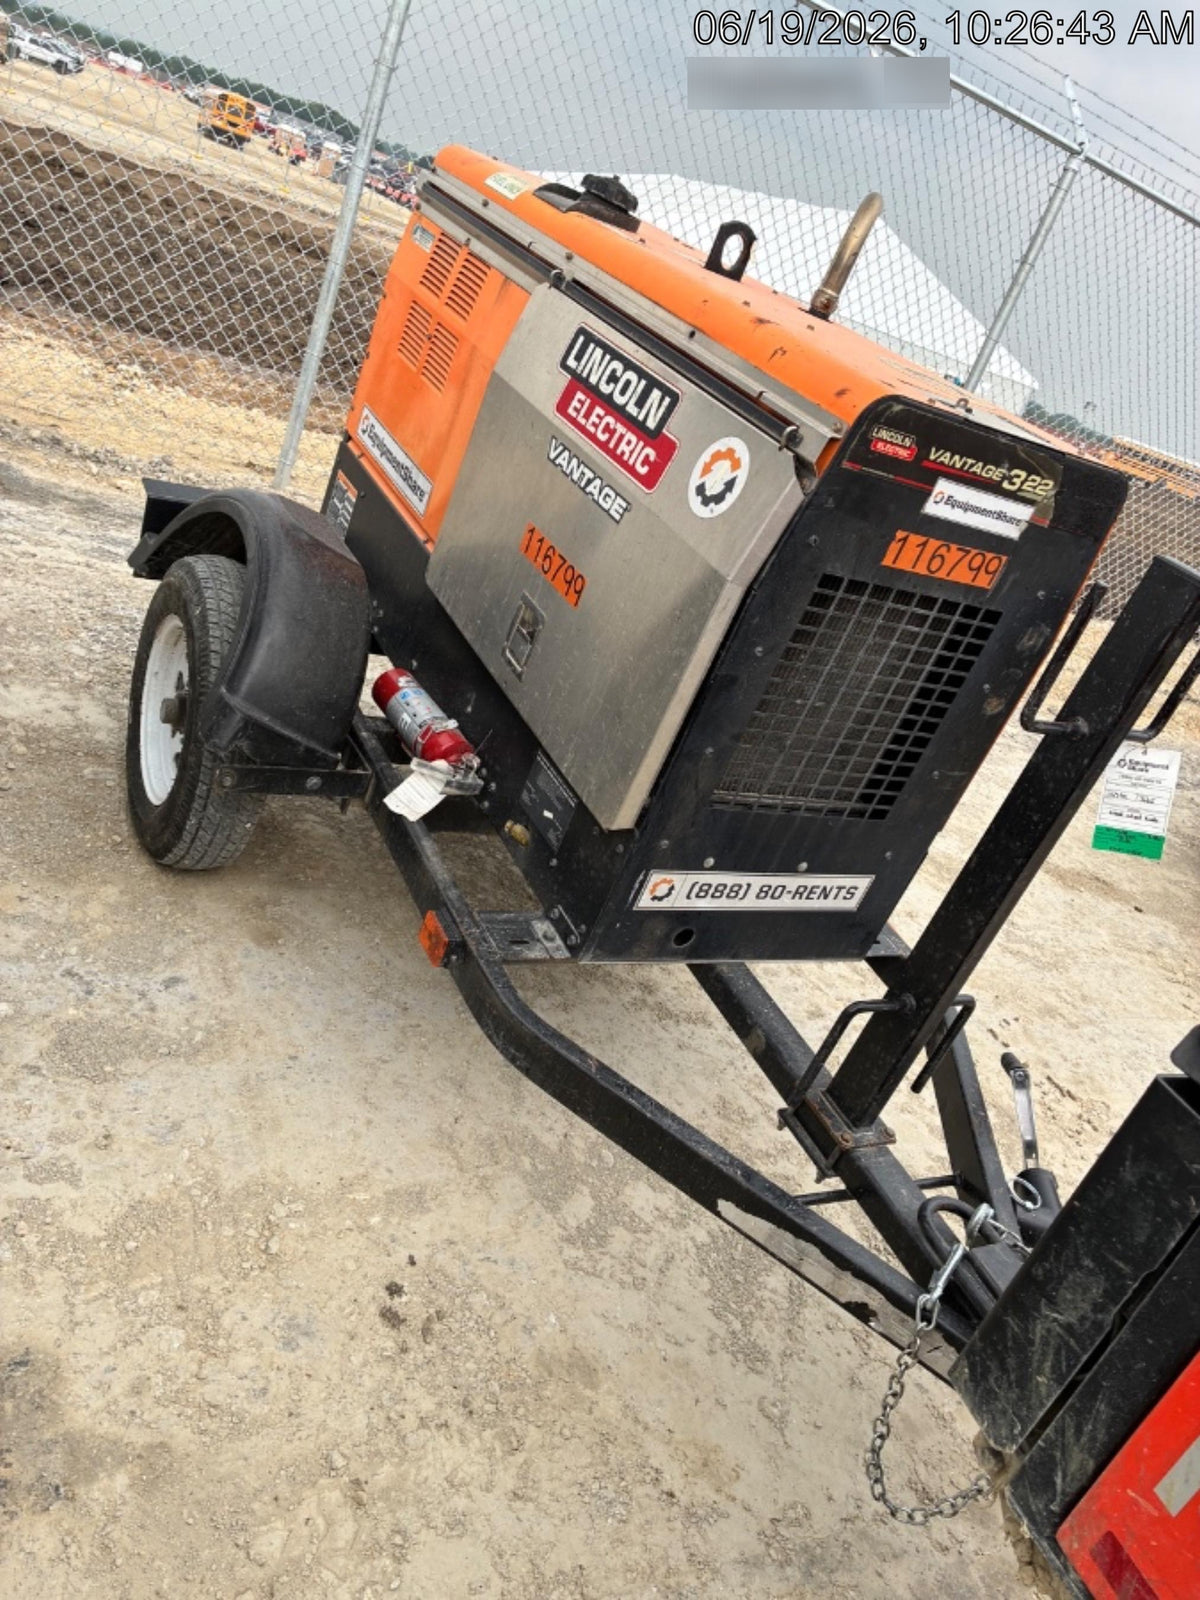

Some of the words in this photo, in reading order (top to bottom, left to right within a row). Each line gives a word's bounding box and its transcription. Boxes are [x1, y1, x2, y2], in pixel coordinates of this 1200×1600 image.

[566, 335, 671, 431] LINCOLN
[566, 390, 656, 475] ELECTRIC
[872, 426, 914, 448] LINCOLN
[875, 441, 912, 459] ELECTRIC
[367, 422, 426, 503] EquipmentShare
[548, 436, 630, 522] VANTAGE
[928, 446, 1009, 481] VANTAGE
[1002, 468, 1055, 497] 322
[943, 495, 1022, 528] EquipmentShare
[523, 527, 586, 607] 116799
[891, 534, 1003, 587] 116799
[686, 881, 752, 901] (888)
[755, 884, 859, 901] 80-RENTS
